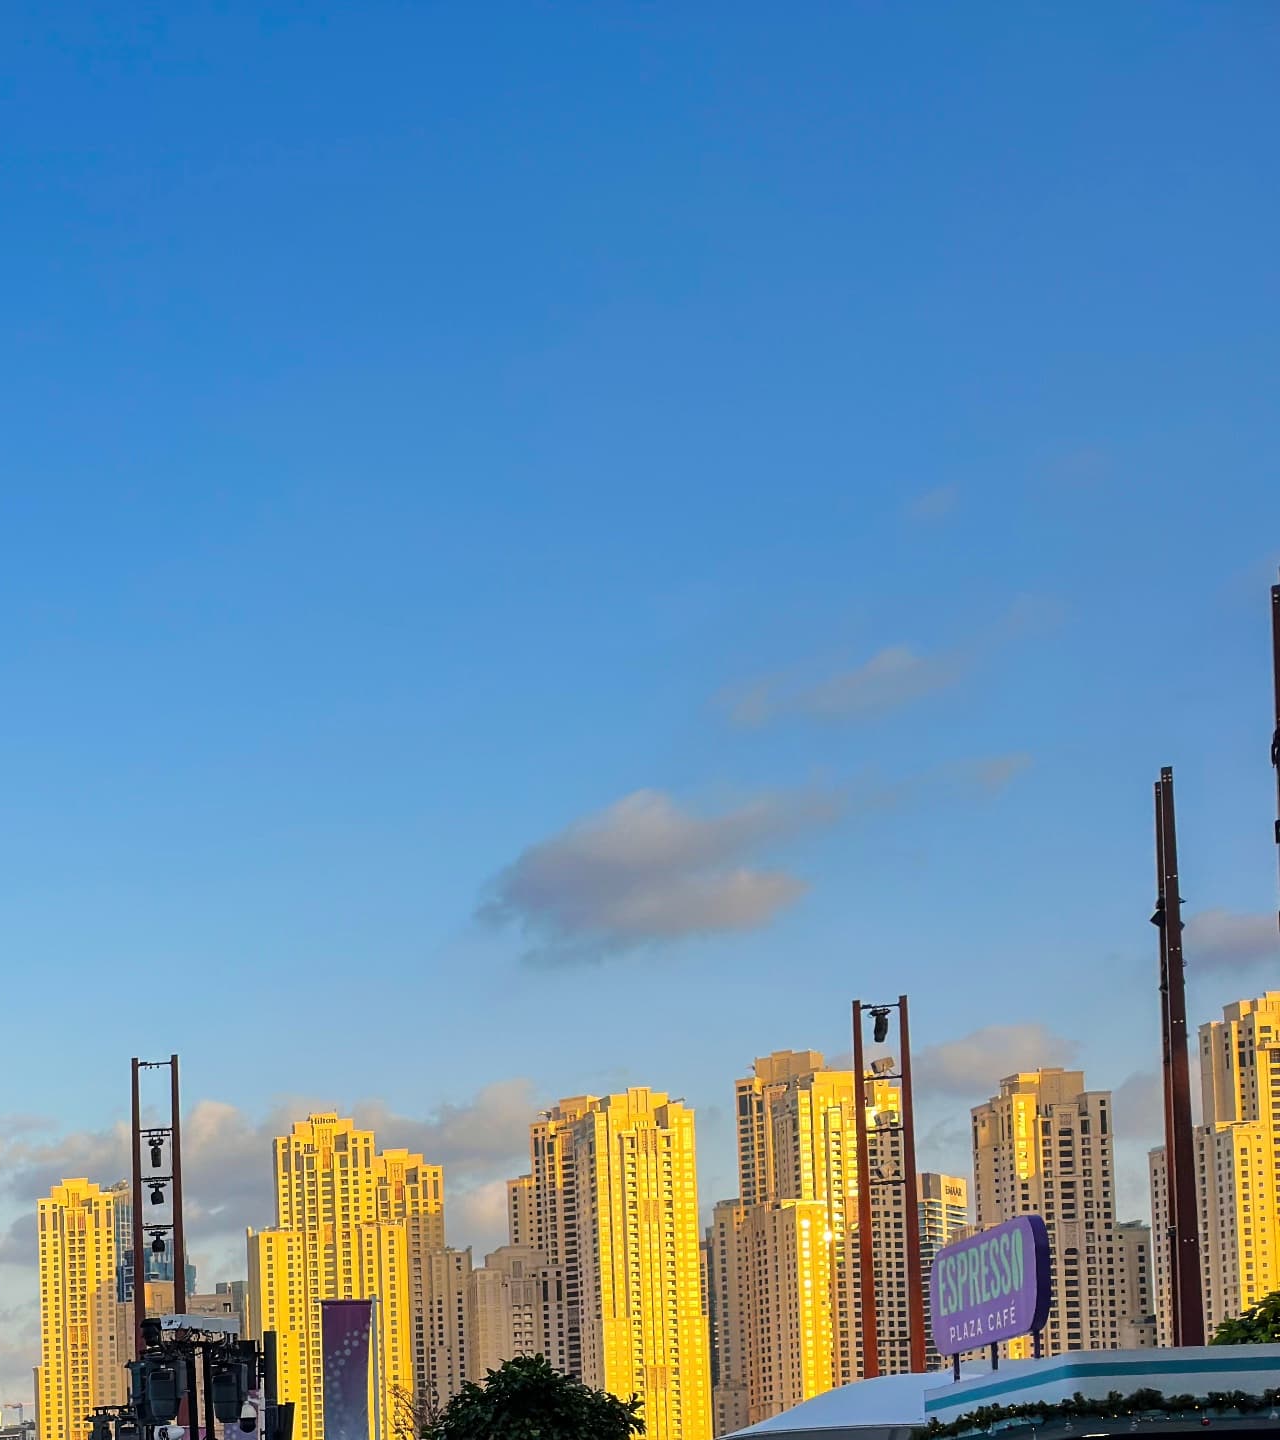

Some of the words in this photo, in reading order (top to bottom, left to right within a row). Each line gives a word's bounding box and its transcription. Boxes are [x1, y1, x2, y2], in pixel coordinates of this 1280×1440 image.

[945, 1185, 961, 1196] EMAAR
[937, 1228, 1023, 1317] ESPRESSO
[950, 1318, 983, 1345] PLAZA
[988, 1300, 1017, 1332] CAFÉ
